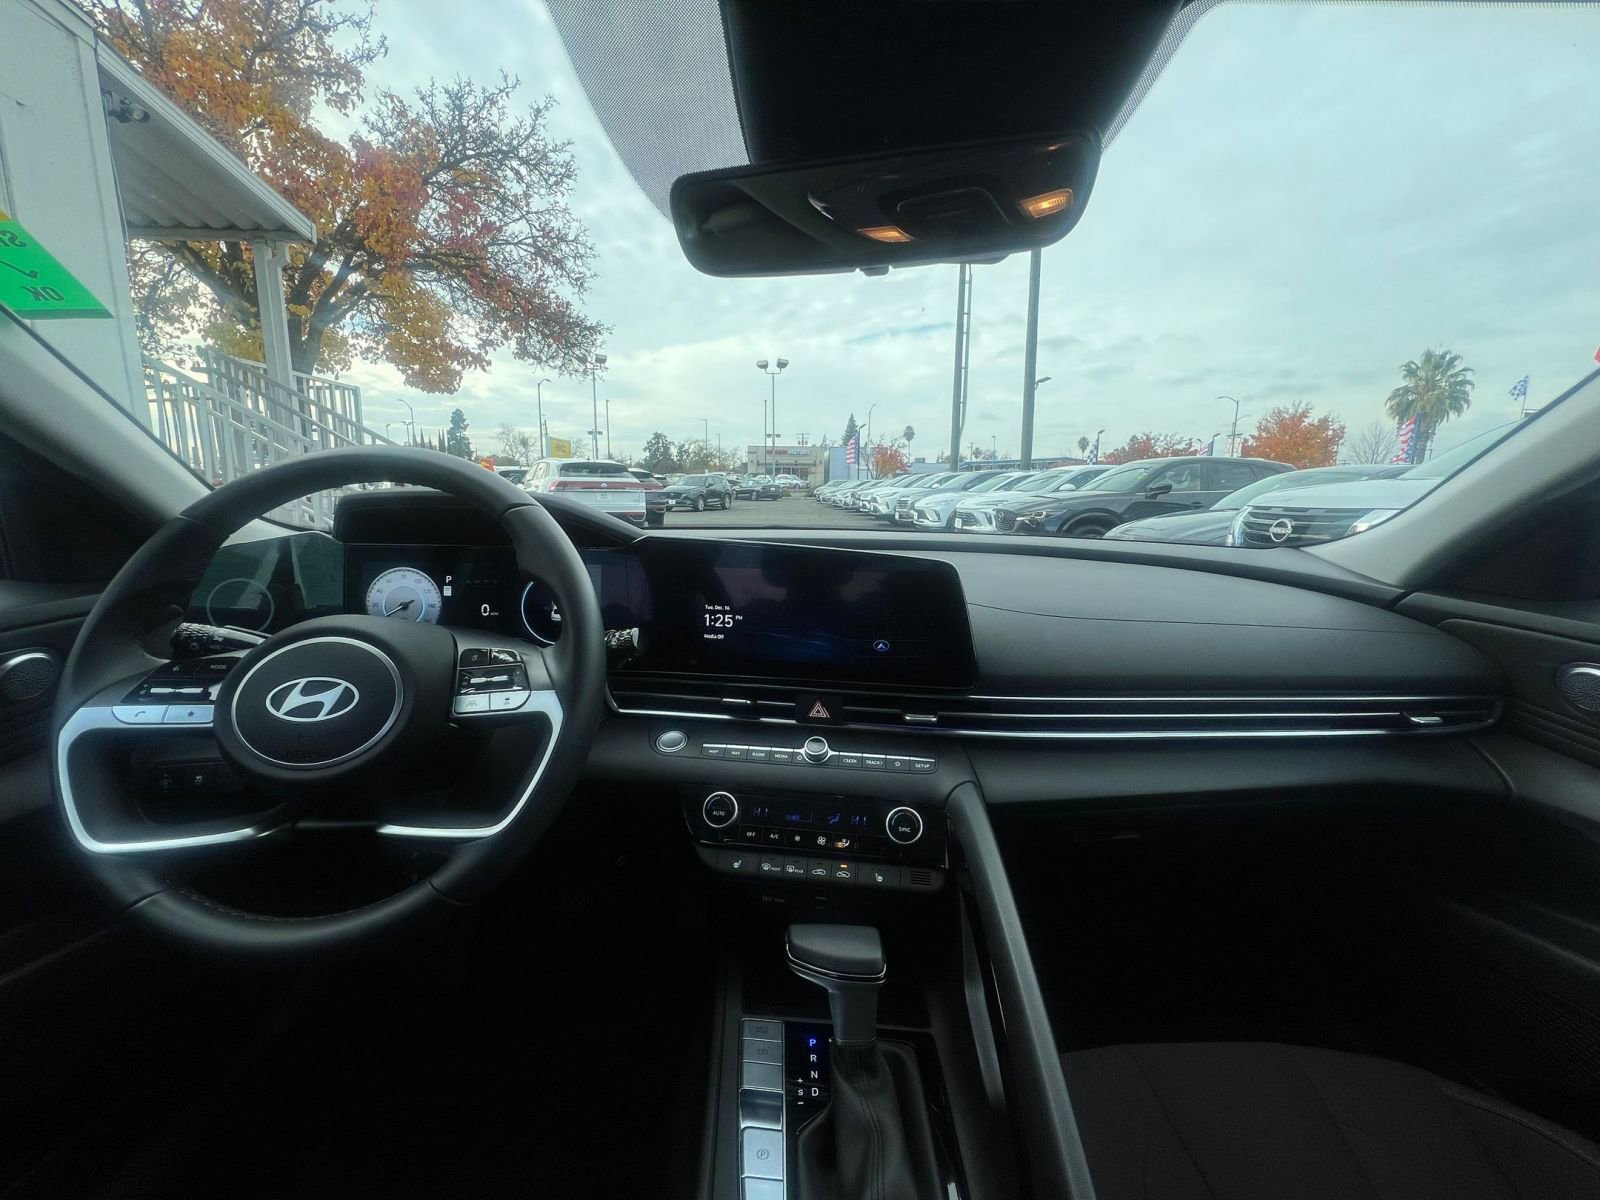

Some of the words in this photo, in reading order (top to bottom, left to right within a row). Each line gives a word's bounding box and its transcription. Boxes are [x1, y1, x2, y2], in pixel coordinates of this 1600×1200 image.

[445, 575, 452, 584] P
[481, 603, 490, 617] 0
[704, 613, 734, 628] 1:25
[809, 1038, 817, 1047] P
[810, 1054, 817, 1062] R
[810, 1070, 819, 1079] N
[811, 1087, 819, 1097] D
